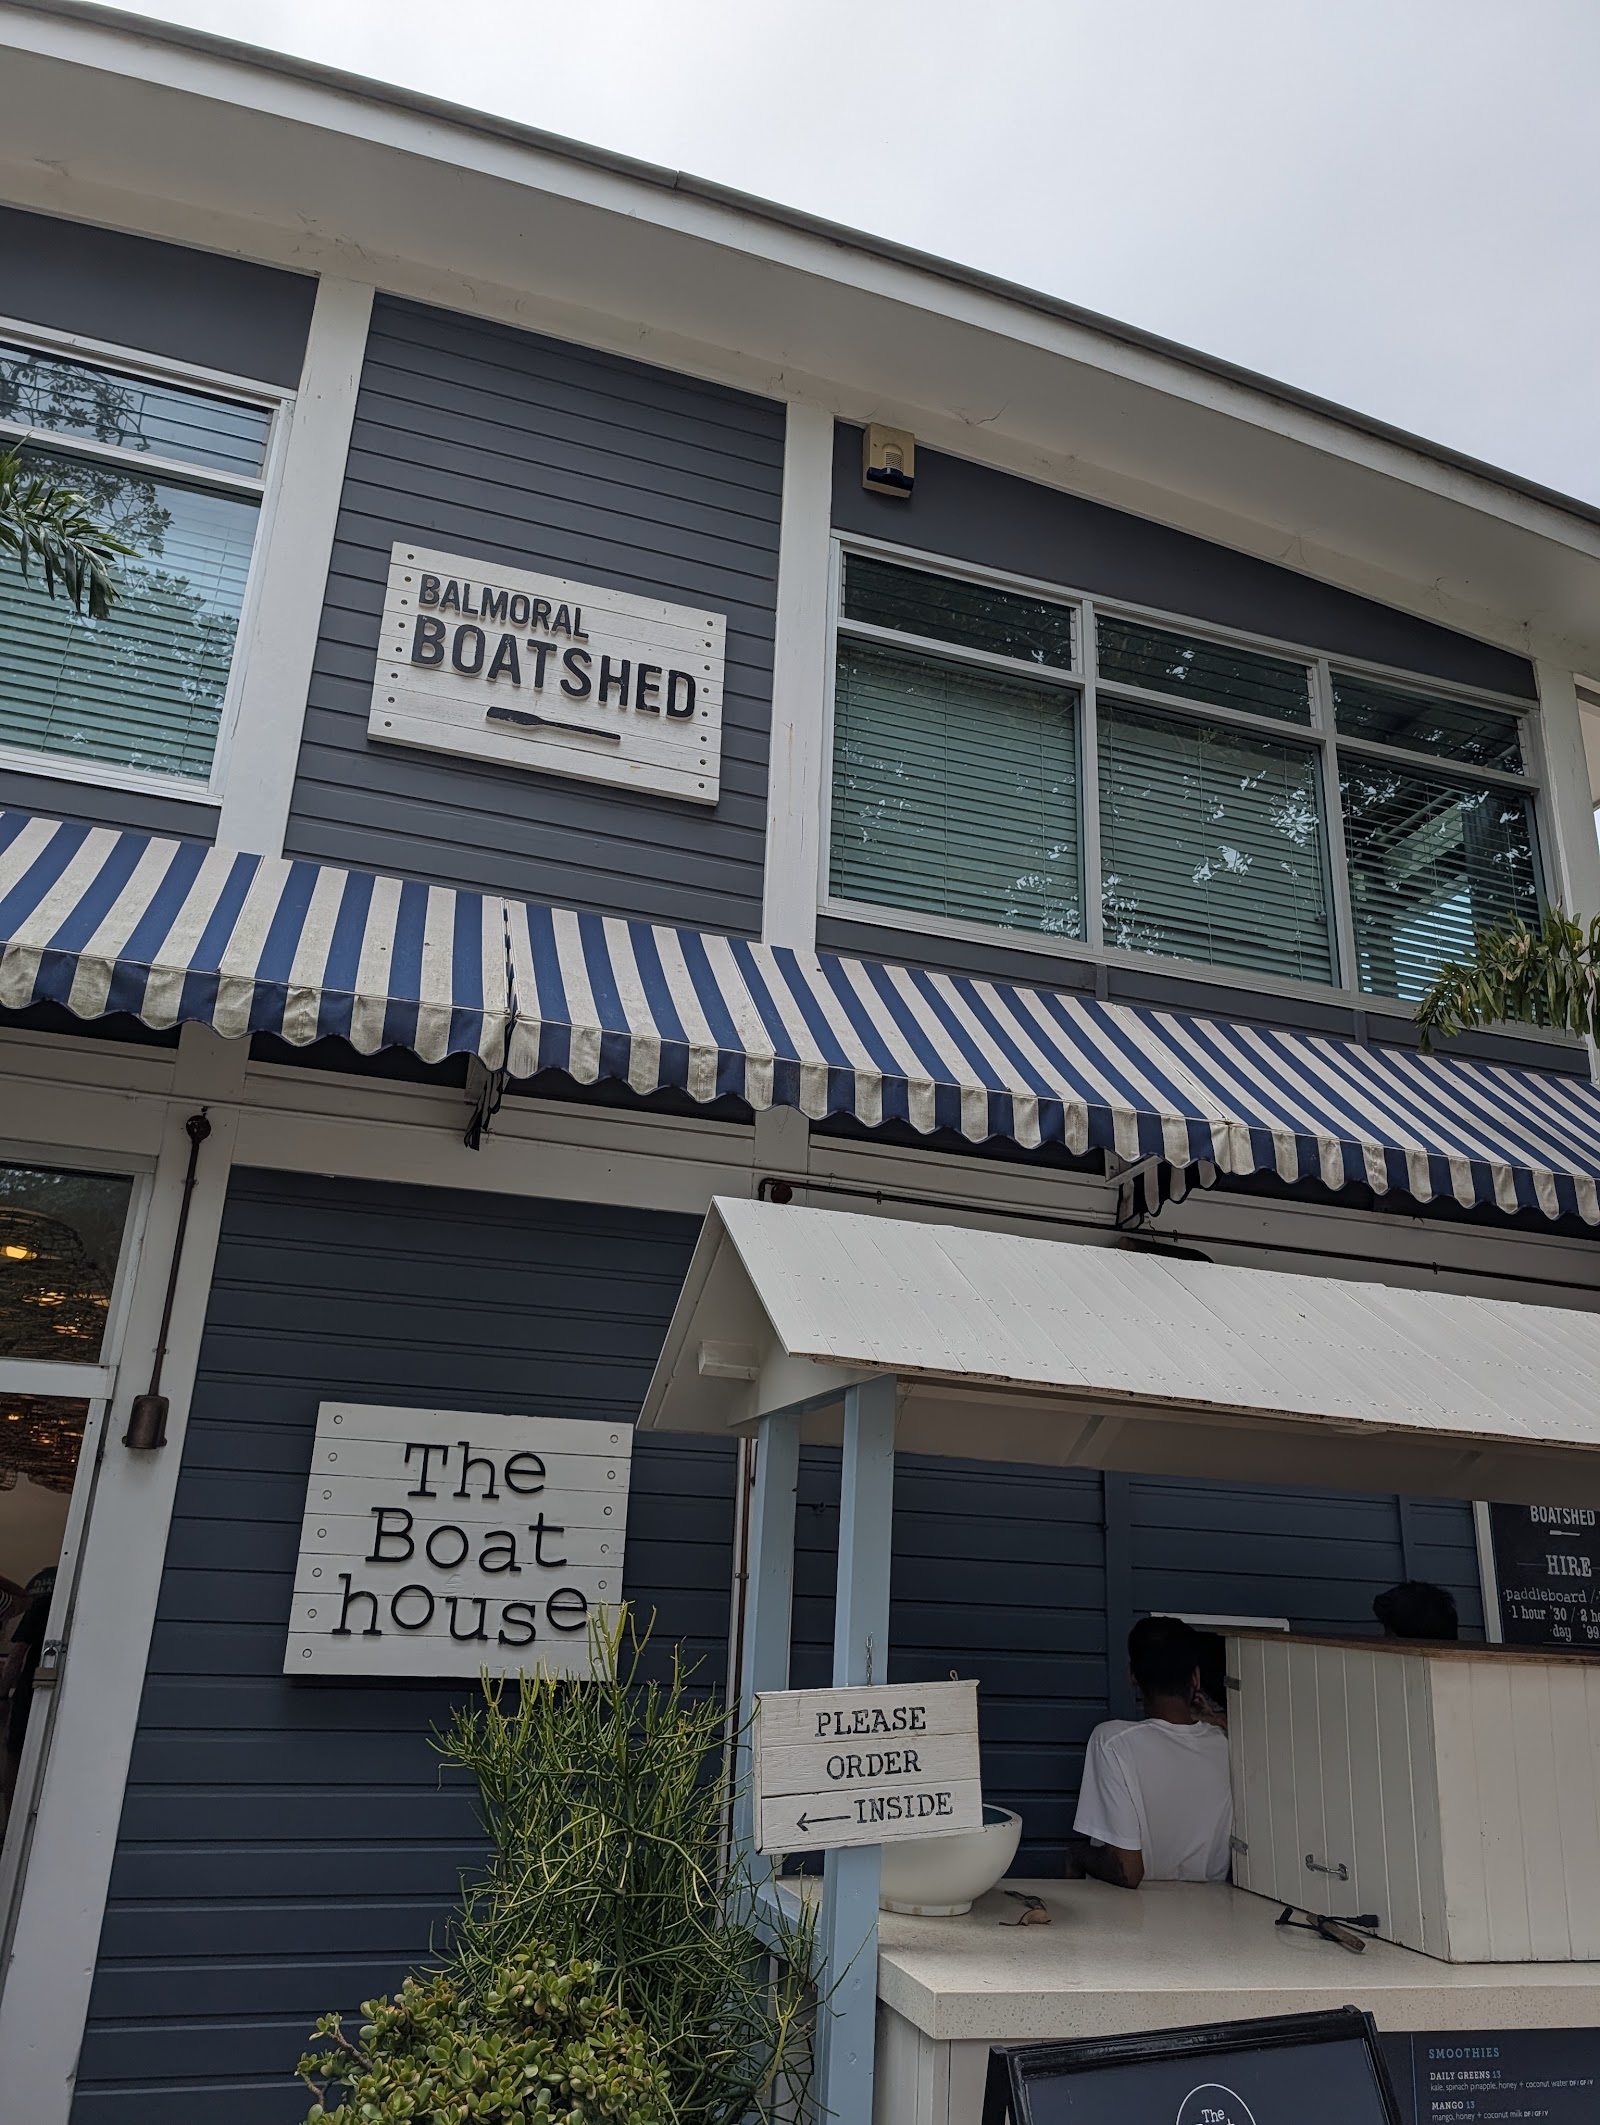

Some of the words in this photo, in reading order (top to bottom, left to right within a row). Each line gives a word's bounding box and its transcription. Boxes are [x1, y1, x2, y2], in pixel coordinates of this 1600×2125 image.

[418, 573, 590, 641] BALMORAL
[411, 614, 697, 720] BOATSHED
[404, 1441, 546, 1499] The
[1530, 1505, 1596, 1526] BOATSHED
[365, 1507, 567, 1573] Boat
[1546, 1554, 1592, 1577] HIRE
[1505, 1587, 1587, 1603] paddleboard
[331, 1573, 588, 1646] house
[1521, 1605, 1546, 1620] hour
[1553, 1623, 1572, 1642] day
[815, 1707, 926, 1737] PLEASE
[827, 1750, 921, 1780] ORDER
[854, 1792, 953, 1824] INSIDE
[1428, 2047, 1500, 2058] SMOOTHIES
[1430, 2072, 1455, 2080] DAILY
[1457, 2070, 1491, 2080] GREENS
[1499, 2080, 1518, 2091] honey
[1526, 2080, 1550, 2089] coconut
[1201, 2108, 1225, 2123] The
[1431, 2101, 1464, 2111] MANGO
[1466, 2100, 1475, 2109] 13
[1456, 2111, 1475, 2122] honey
